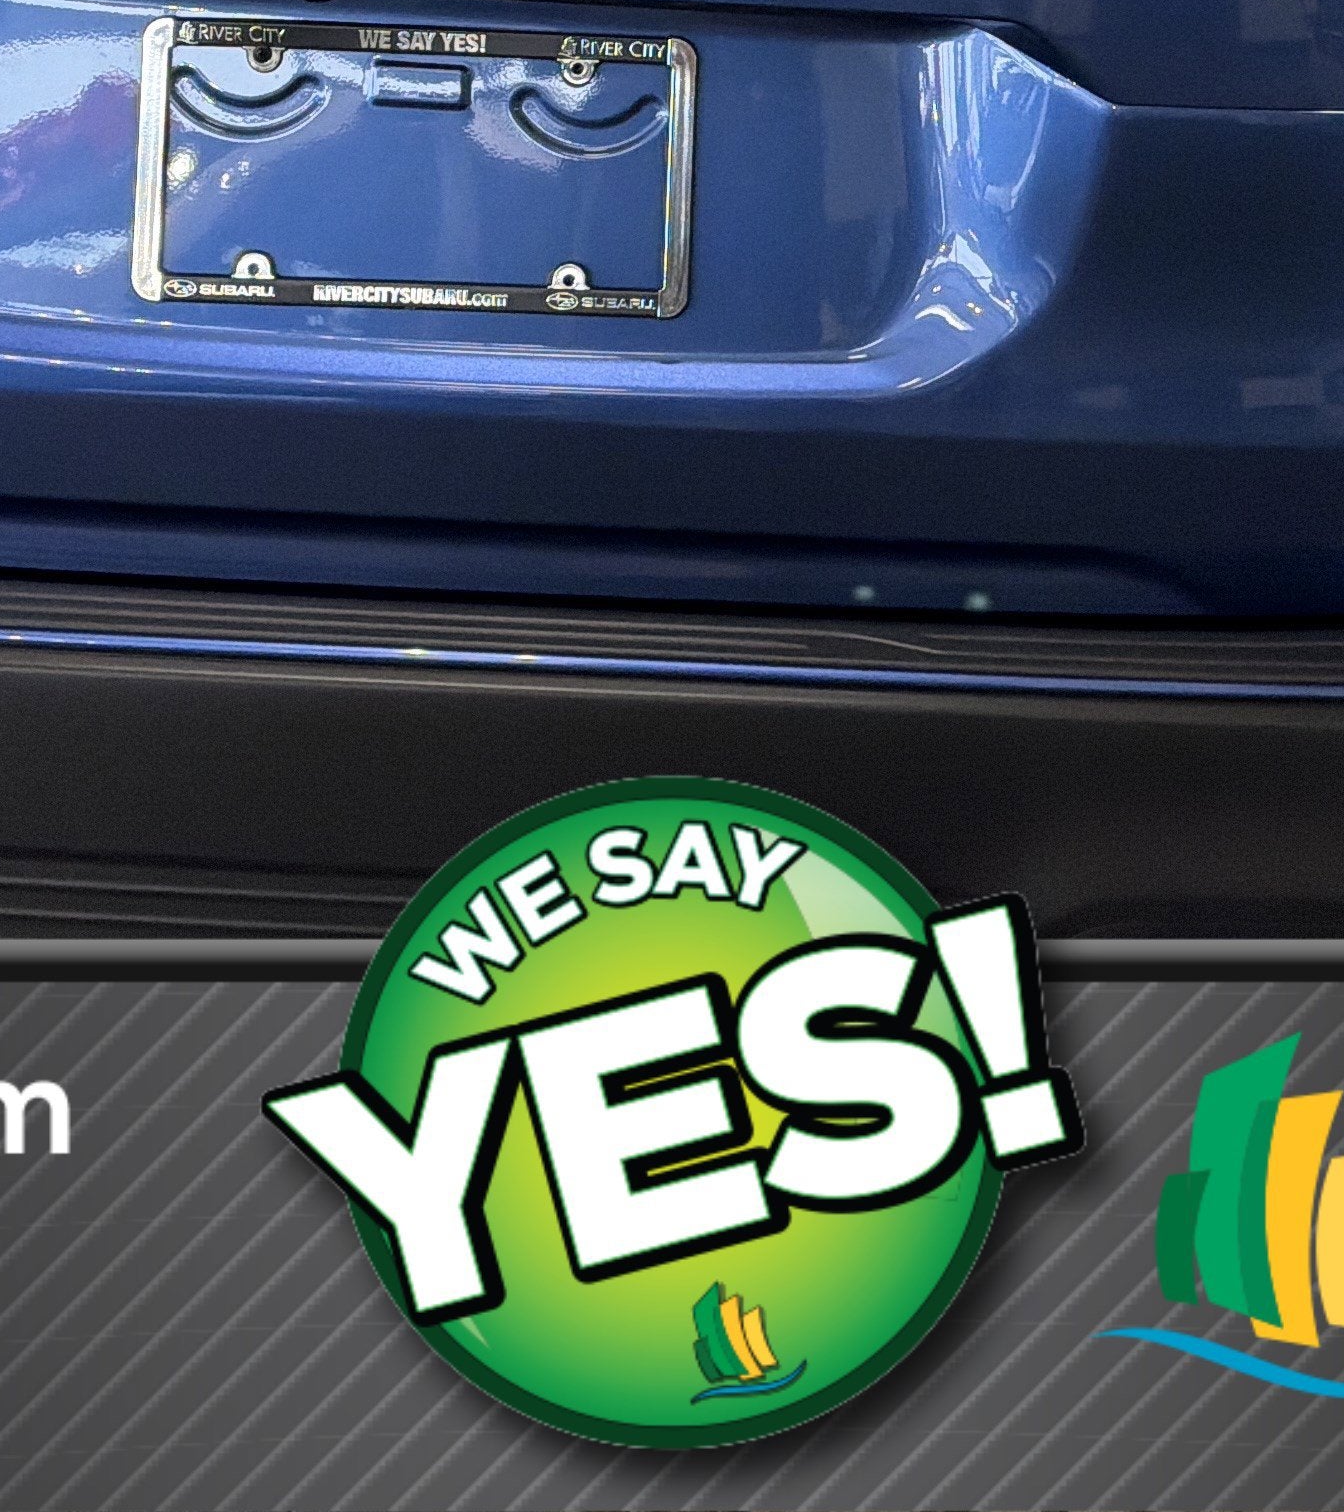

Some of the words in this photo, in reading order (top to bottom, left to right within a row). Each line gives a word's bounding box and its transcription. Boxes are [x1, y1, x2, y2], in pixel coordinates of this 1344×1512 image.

[197, 23, 242, 42] RIVER
[248, 25, 287, 44] CITY
[358, 29, 392, 49] WE
[396, 31, 436, 51] SAY
[439, 33, 487, 54] YES!
[579, 37, 623, 57] RIVER
[628, 39, 667, 59] CITY
[199, 284, 275, 298] SUBARU
[313, 284, 509, 308] RIVERCITYSUBARU.com
[580, 297, 656, 311] SUBARU
